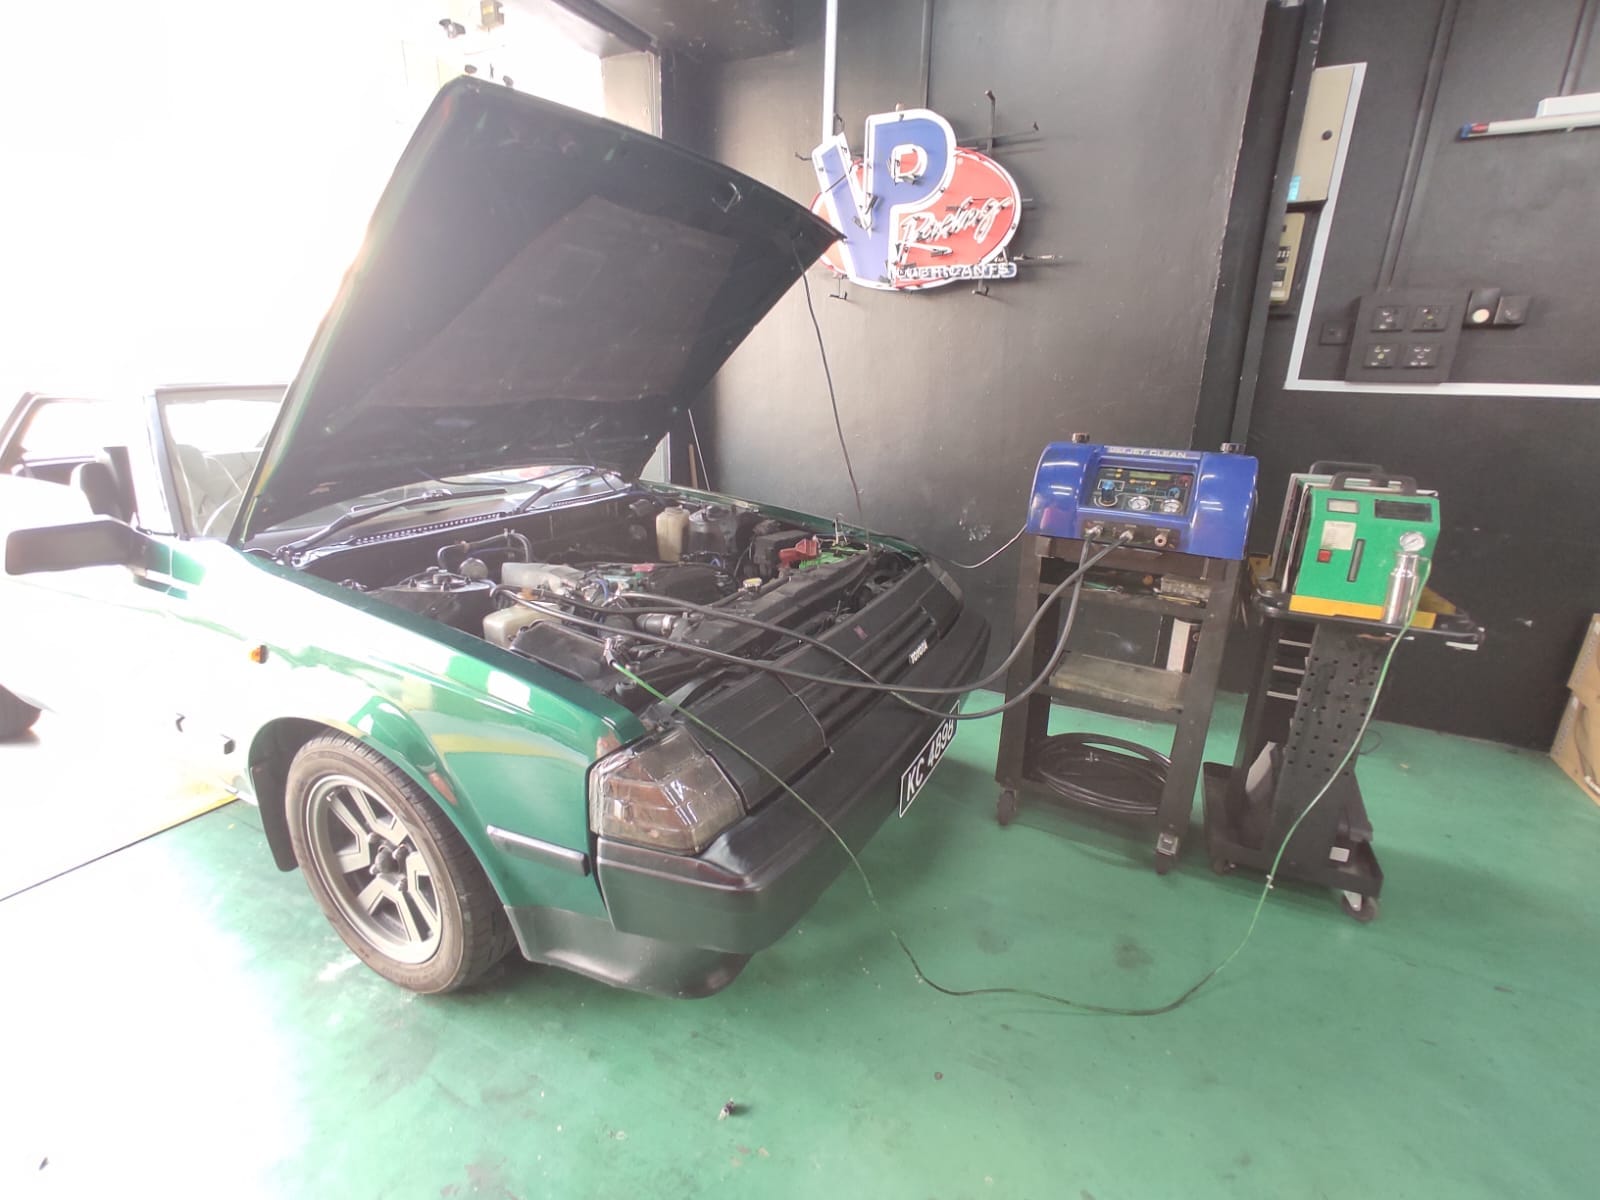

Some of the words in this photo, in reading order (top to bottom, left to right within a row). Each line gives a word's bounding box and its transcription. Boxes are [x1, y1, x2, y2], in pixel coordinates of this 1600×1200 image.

[811, 108, 957, 287] VP
[898, 196, 1013, 262] Racing
[906, 757, 925, 802] KC
[927, 718, 954, 767] 4898
